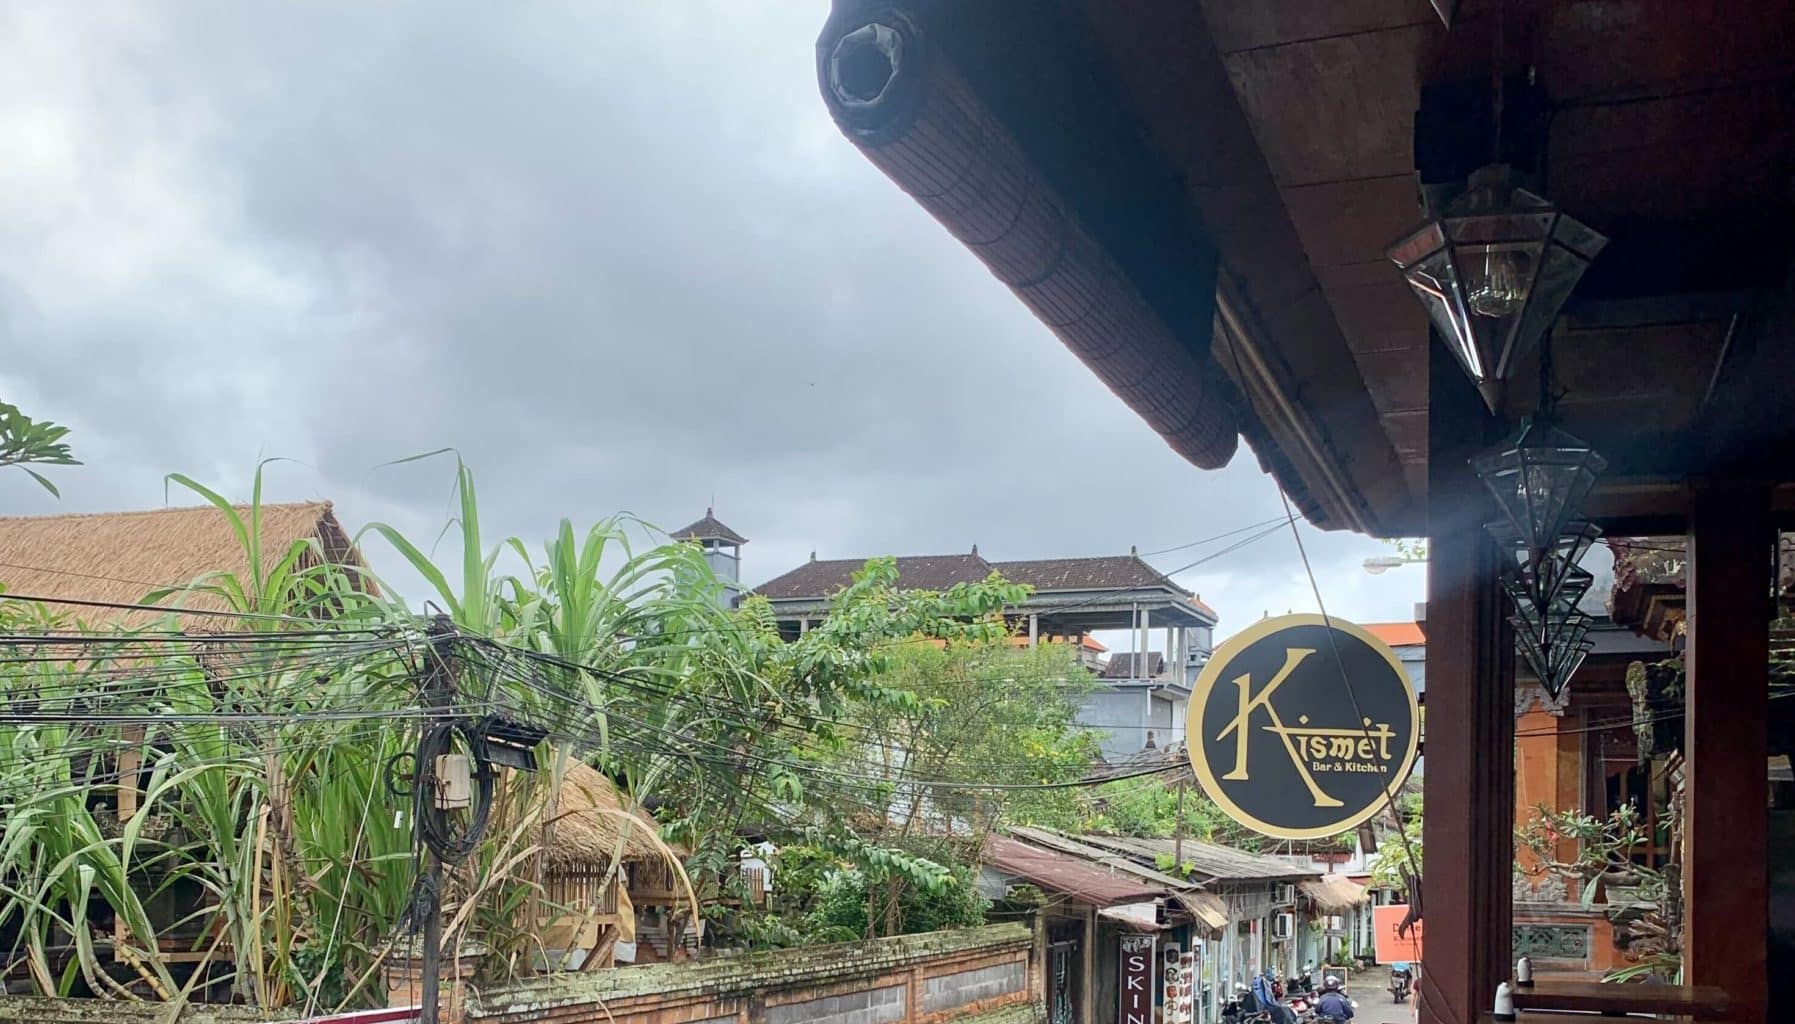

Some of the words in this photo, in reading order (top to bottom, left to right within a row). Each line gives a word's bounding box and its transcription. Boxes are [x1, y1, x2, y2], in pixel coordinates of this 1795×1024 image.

[1216, 648, 1396, 807] Kismet
[1312, 761, 1332, 772] Bar
[1333, 761, 1343, 772] &
